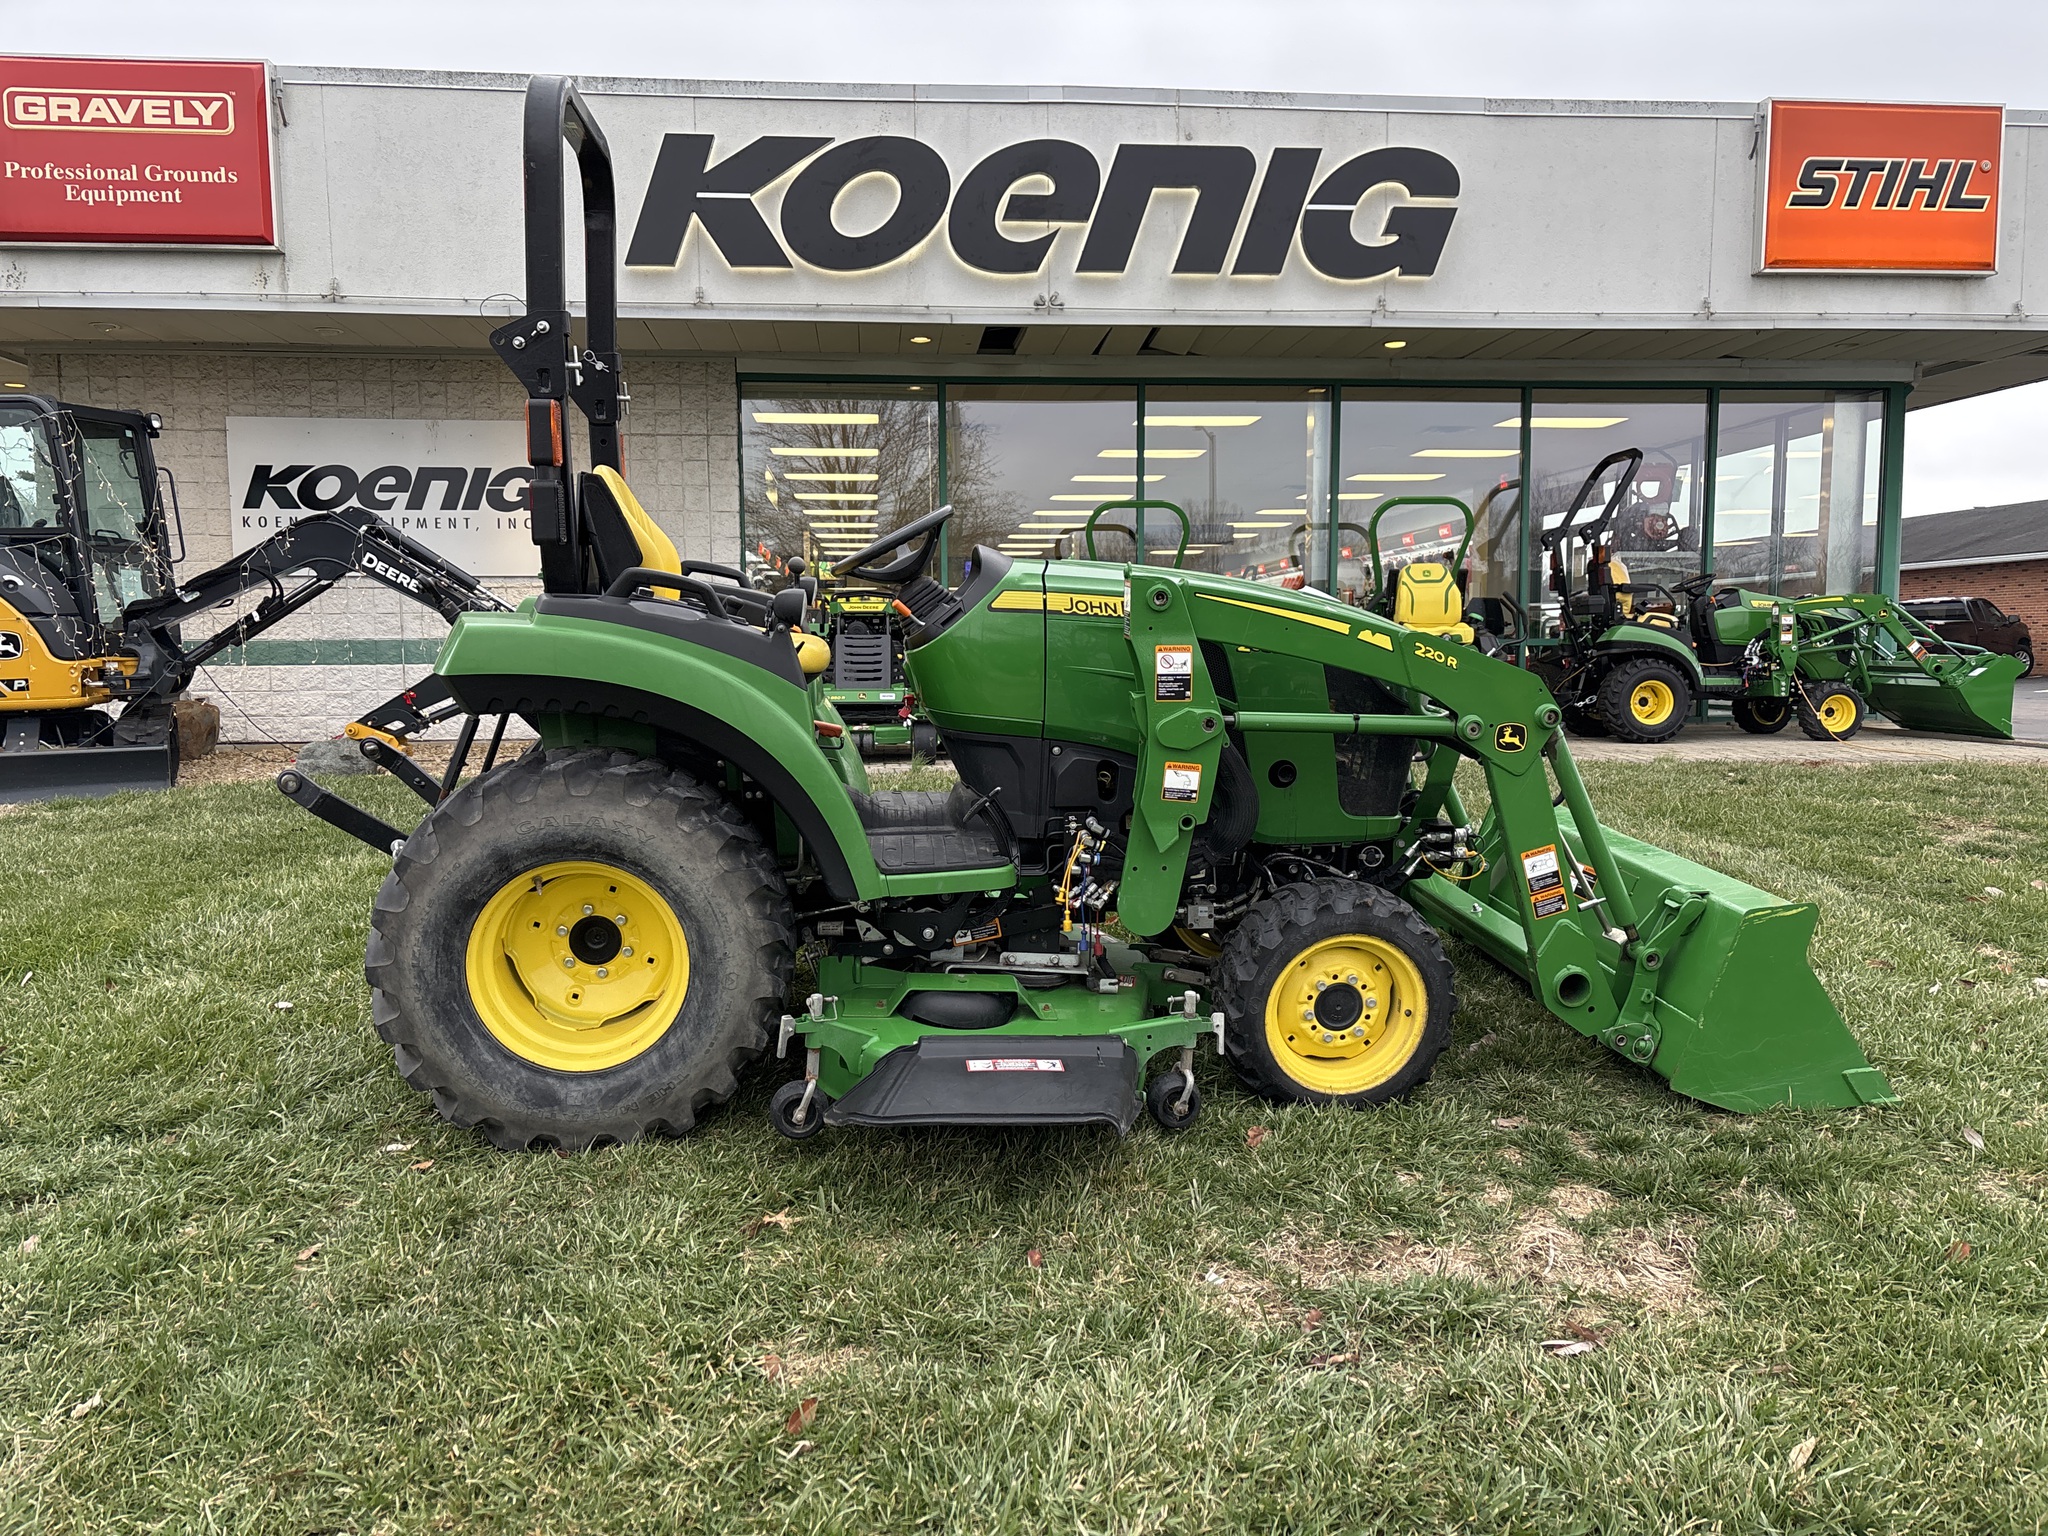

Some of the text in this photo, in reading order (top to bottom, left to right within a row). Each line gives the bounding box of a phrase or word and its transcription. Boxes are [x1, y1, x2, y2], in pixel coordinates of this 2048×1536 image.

[14, 95, 224, 126] GRAVELY
[4, 161, 238, 183] Professional Grounds
[64, 184, 183, 206] Equipment
[1784, 156, 1992, 212] STIHL
[241, 515, 298, 529] KOEN
[362, 551, 420, 594] DEERE
[1063, 596, 1119, 616] JOHN
[1172, 763, 1200, 771] WARNING
[515, 814, 657, 843] GALAXY
